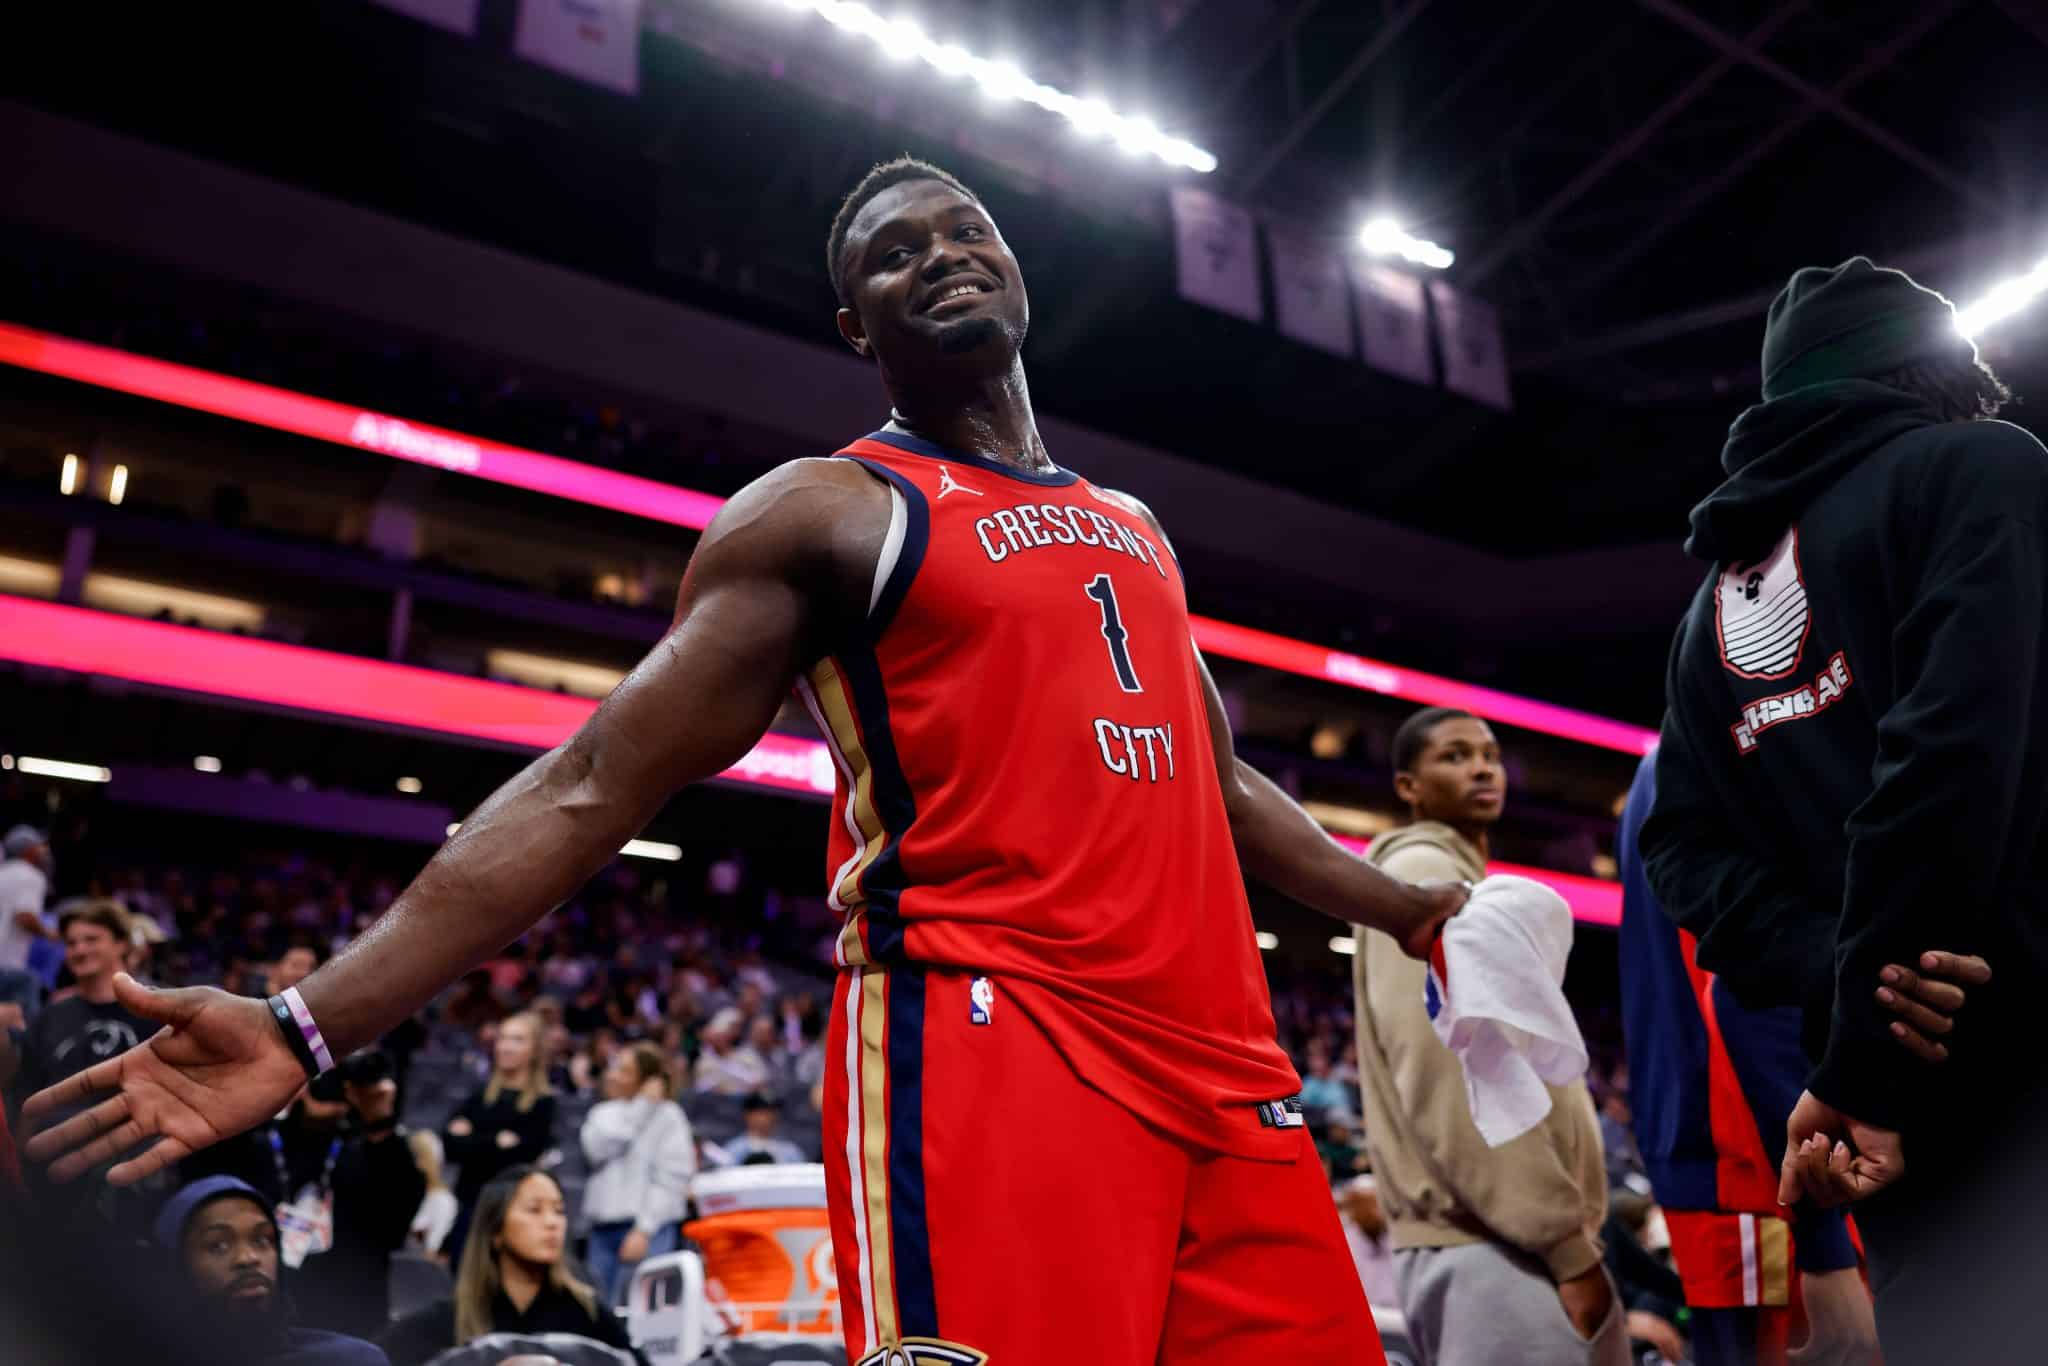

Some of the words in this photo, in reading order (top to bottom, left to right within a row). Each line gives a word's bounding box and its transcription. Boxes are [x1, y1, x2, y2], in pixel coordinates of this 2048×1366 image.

[975, 504, 1167, 578] CRESCENT
[1084, 573, 1144, 693] 1
[1094, 718, 1174, 782] CITY
